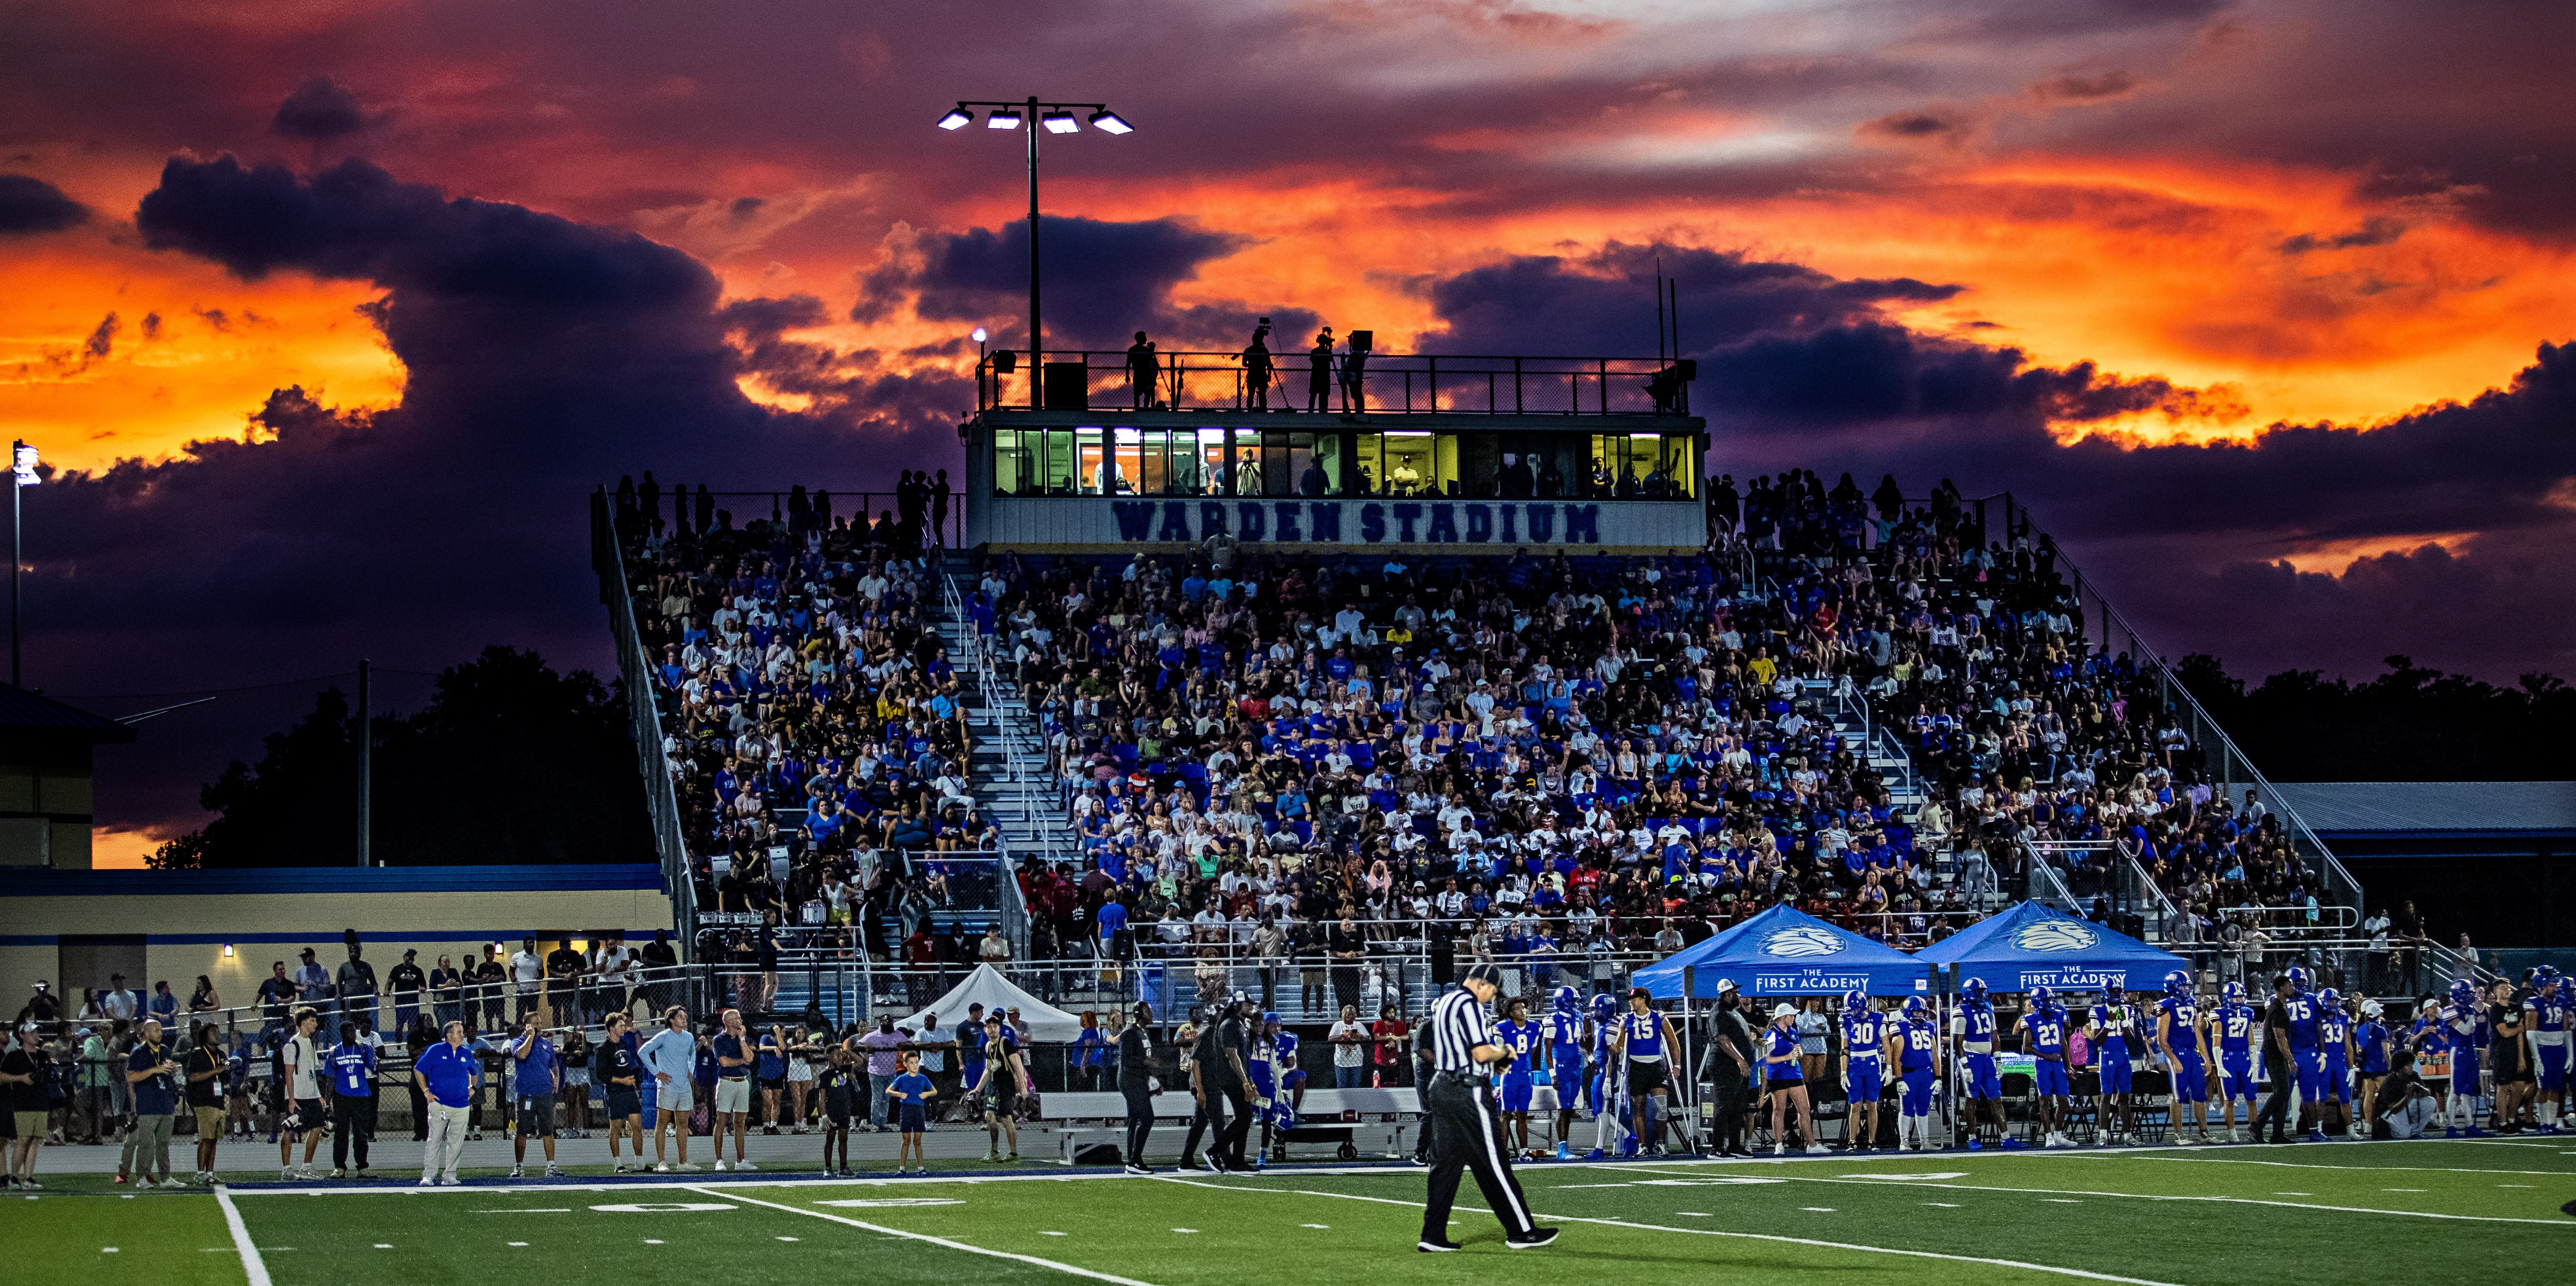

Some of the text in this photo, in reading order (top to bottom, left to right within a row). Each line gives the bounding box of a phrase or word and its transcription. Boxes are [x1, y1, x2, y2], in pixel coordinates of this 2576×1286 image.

[1112, 502, 1598, 543] WARDEN STADIUM
[1757, 978, 1869, 992] FIRST ACADEMY
[2021, 975, 2057, 989] FIRST
[2176, 1006, 2195, 1027] 57
[2286, 1001, 2311, 1022] 75
[1565, 1022, 1581, 1044] 14
[1633, 1020, 1654, 1040] 15
[1851, 1022, 1874, 1044] 30
[1974, 1013, 1992, 1034] 13
[2228, 1017, 2248, 1038] 27
[2322, 1023, 2344, 1043] 33
[1516, 1034, 1528, 1054] 8
[1910, 1030, 1931, 1050] 85
[2037, 1023, 2060, 1046] 23
